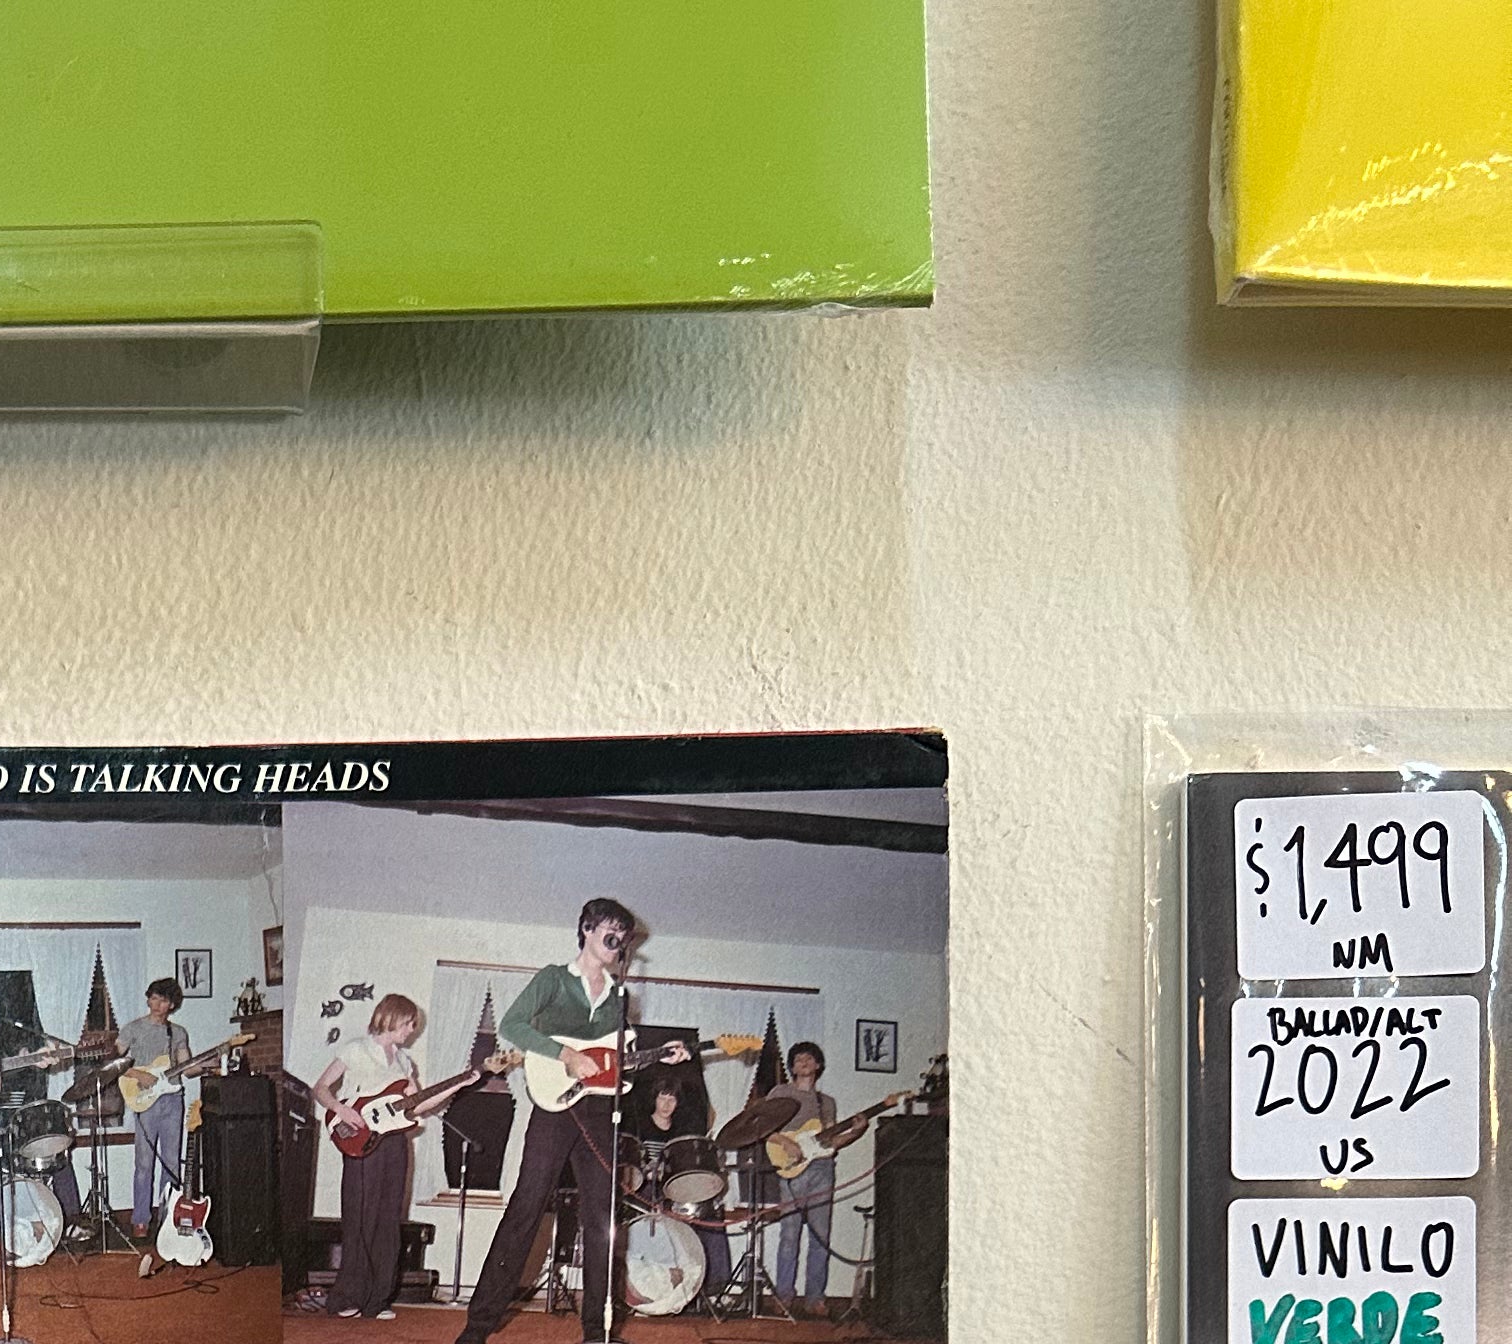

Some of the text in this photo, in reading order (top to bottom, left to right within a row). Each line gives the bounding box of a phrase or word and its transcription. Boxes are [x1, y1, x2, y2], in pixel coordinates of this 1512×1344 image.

[18, 763, 57, 794] IS
[69, 763, 242, 794] TALKING
[253, 761, 391, 793] HEADS
[1246, 818, 1453, 925] $1,499
[1333, 932, 1393, 972] NM
[1267, 1006, 1442, 1046] BALLAD/ALT
[1248, 1037, 1451, 1119] 2022
[1320, 1138, 1374, 1174] US
[1252, 1217, 1454, 1279] VINILO
